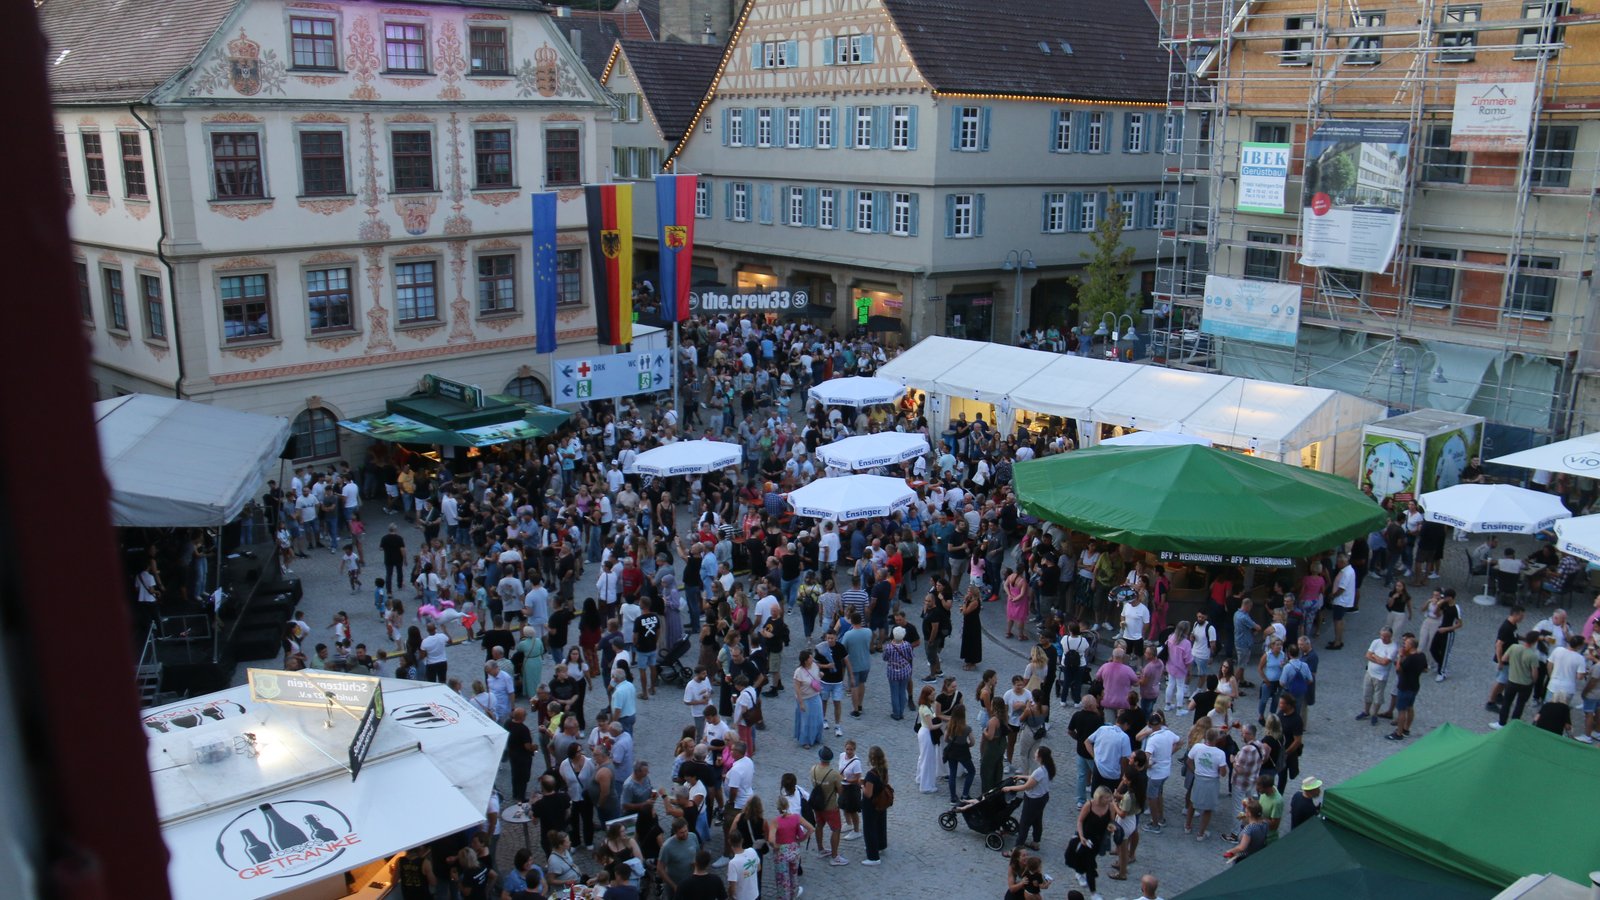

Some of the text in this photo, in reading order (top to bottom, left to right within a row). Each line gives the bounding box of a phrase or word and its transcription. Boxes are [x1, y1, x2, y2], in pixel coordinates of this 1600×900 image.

[1471, 95, 1517, 106] Zimmerei
[1479, 106, 1506, 115] Rama
[1243, 151, 1286, 165] IBEK
[1243, 167, 1282, 176] Gerüstbau
[702, 291, 790, 309] the.crew33
[795, 293, 805, 306] 33
[593, 363, 606, 372] DRK
[828, 397, 854, 405] Ensinger
[862, 396, 889, 404] Ensinger
[902, 446, 924, 460] Ensinger
[713, 457, 737, 468] Ensinger
[857, 456, 892, 467] Ensinger
[637, 465, 659, 474] Ensinger
[669, 465, 702, 475] Ensinger
[892, 496, 912, 510] Ensinger
[803, 507, 833, 518] Ensinger
[845, 508, 882, 519] Ensinger
[1433, 511, 1467, 528] Ensinger
[1481, 521, 1525, 532] Ensinger
[1160, 551, 1173, 560] BFV
[1179, 552, 1223, 563] WEINBRUNNEN
[1230, 556, 1243, 564] BFV
[1249, 557, 1292, 566] WEINBRUNNEN
